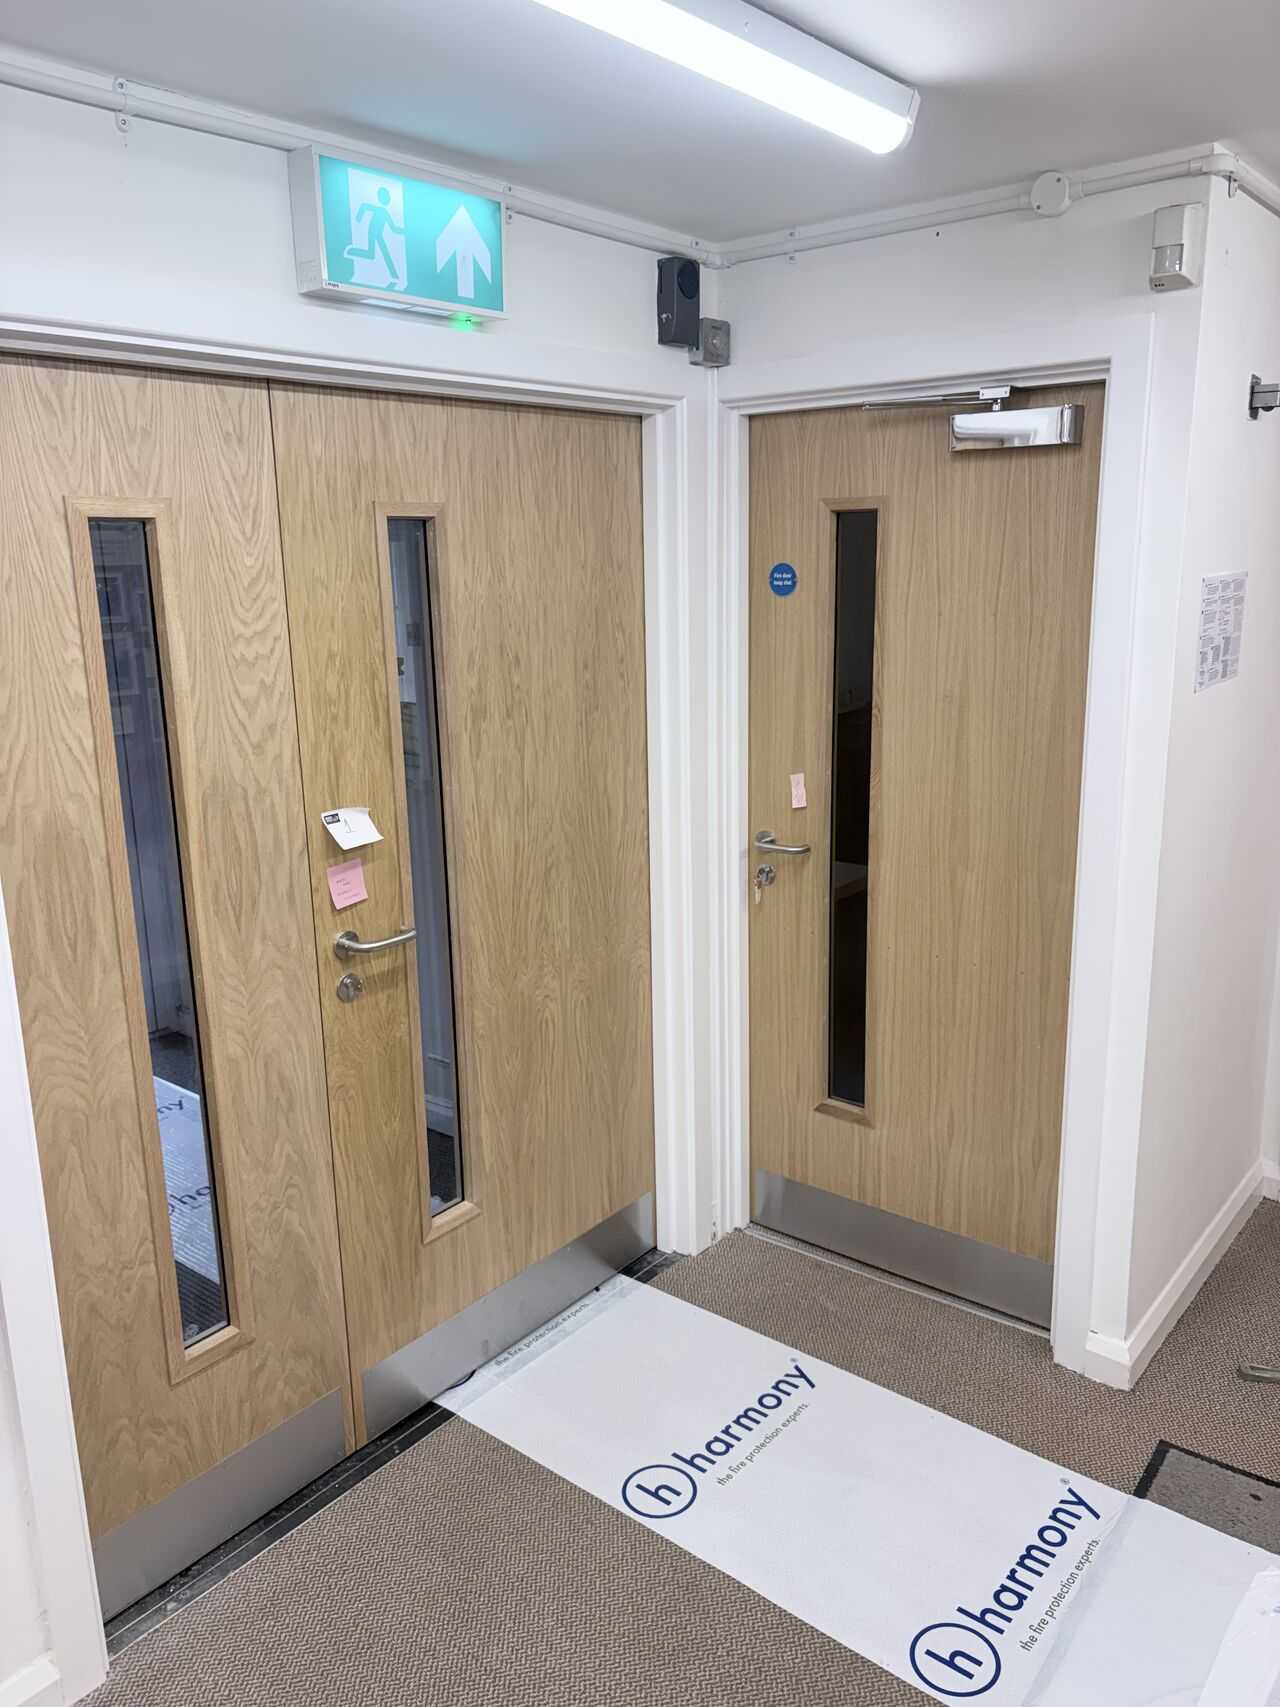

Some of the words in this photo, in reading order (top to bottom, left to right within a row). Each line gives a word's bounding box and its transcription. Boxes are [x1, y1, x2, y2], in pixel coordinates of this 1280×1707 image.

[671, 1363, 816, 1474] harmony
[717, 1472, 734, 1486] the
[727, 1460, 748, 1475] fire
[744, 1426, 783, 1464] protection
[956, 1486, 1101, 1635] harmony
[1074, 1538, 1102, 1572] experts.
[1044, 1570, 1080, 1621] protection
[1019, 1634, 1038, 1652] the
[1028, 1616, 1049, 1636] fire
